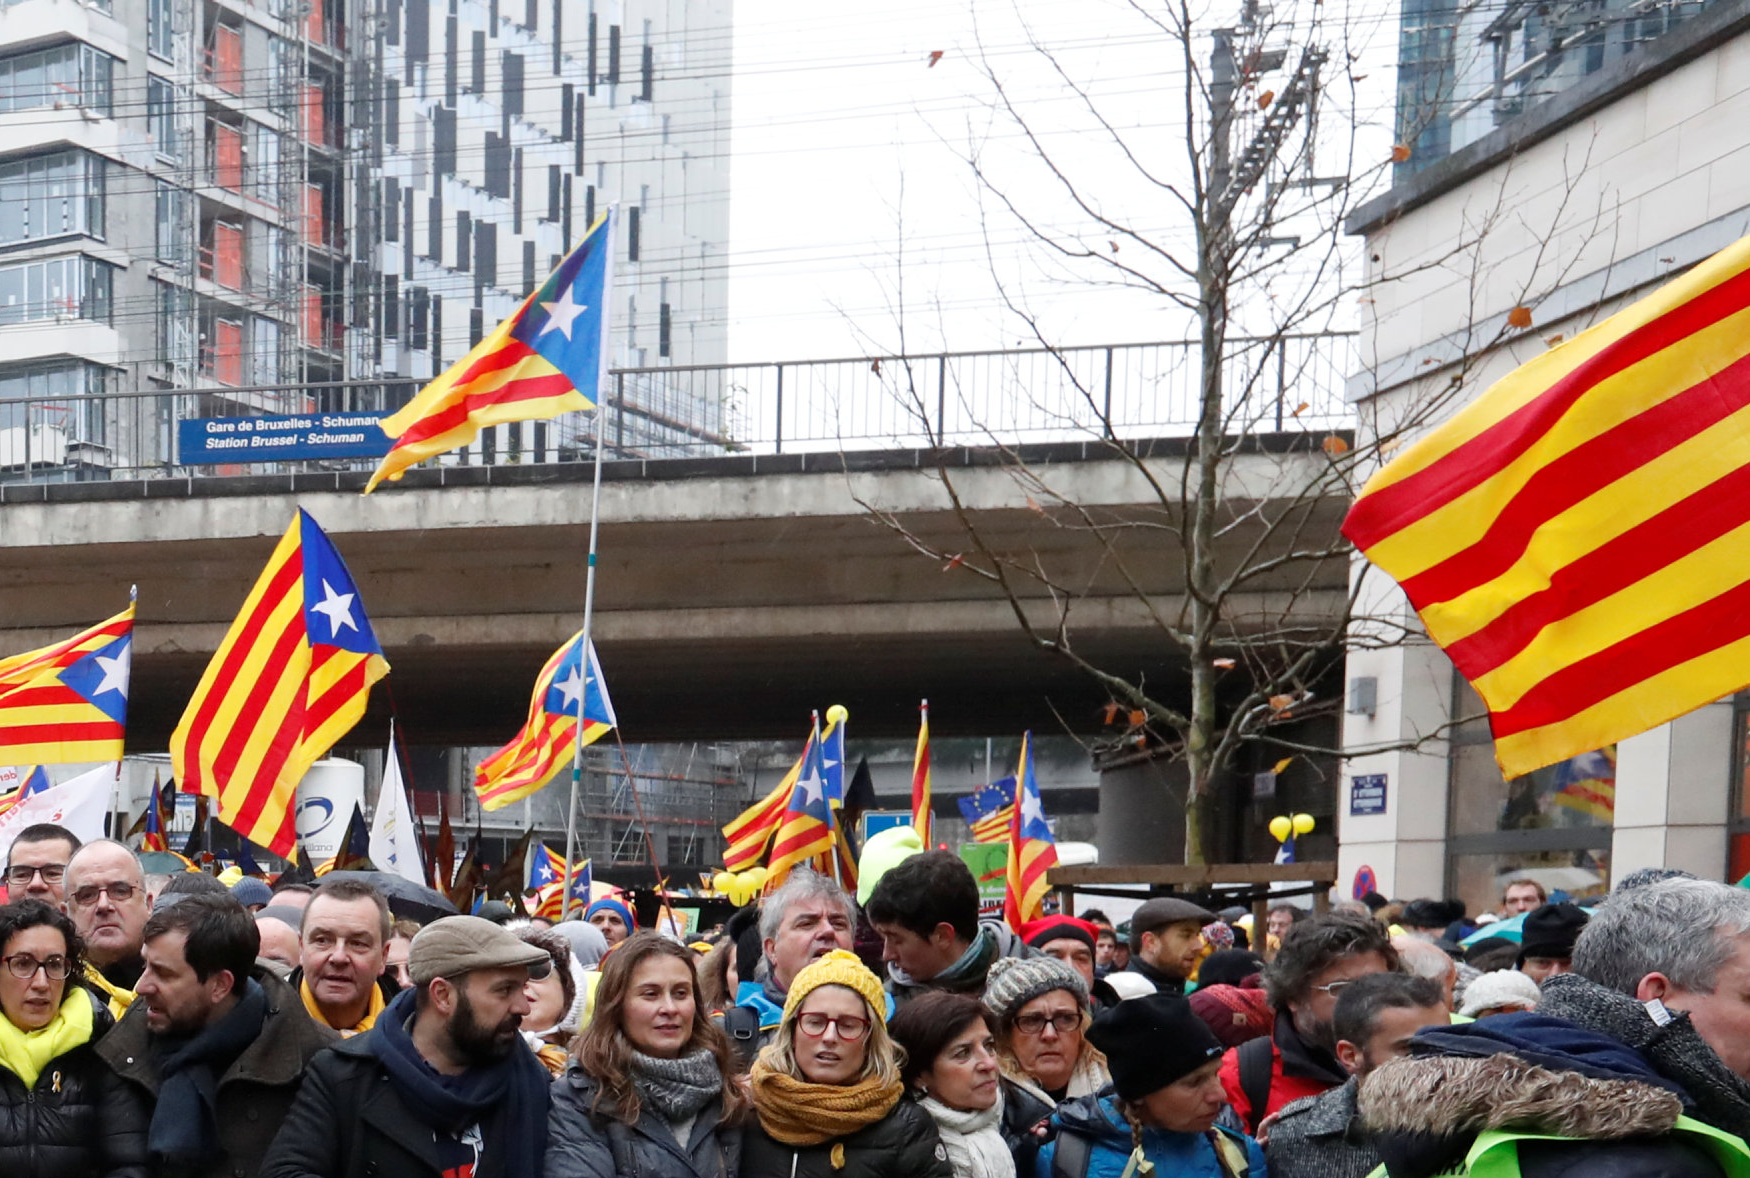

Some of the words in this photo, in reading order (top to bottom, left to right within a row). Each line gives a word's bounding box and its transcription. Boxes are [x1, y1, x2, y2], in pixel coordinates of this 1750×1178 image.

[206, 421, 236, 433] Gare
[238, 420, 253, 431] de
[256, 417, 312, 431] Bruxelles
[322, 415, 380, 428] Schuman
[205, 436, 248, 449] Station
[251, 434, 298, 447] Brussel
[307, 431, 365, 445] Schuman
